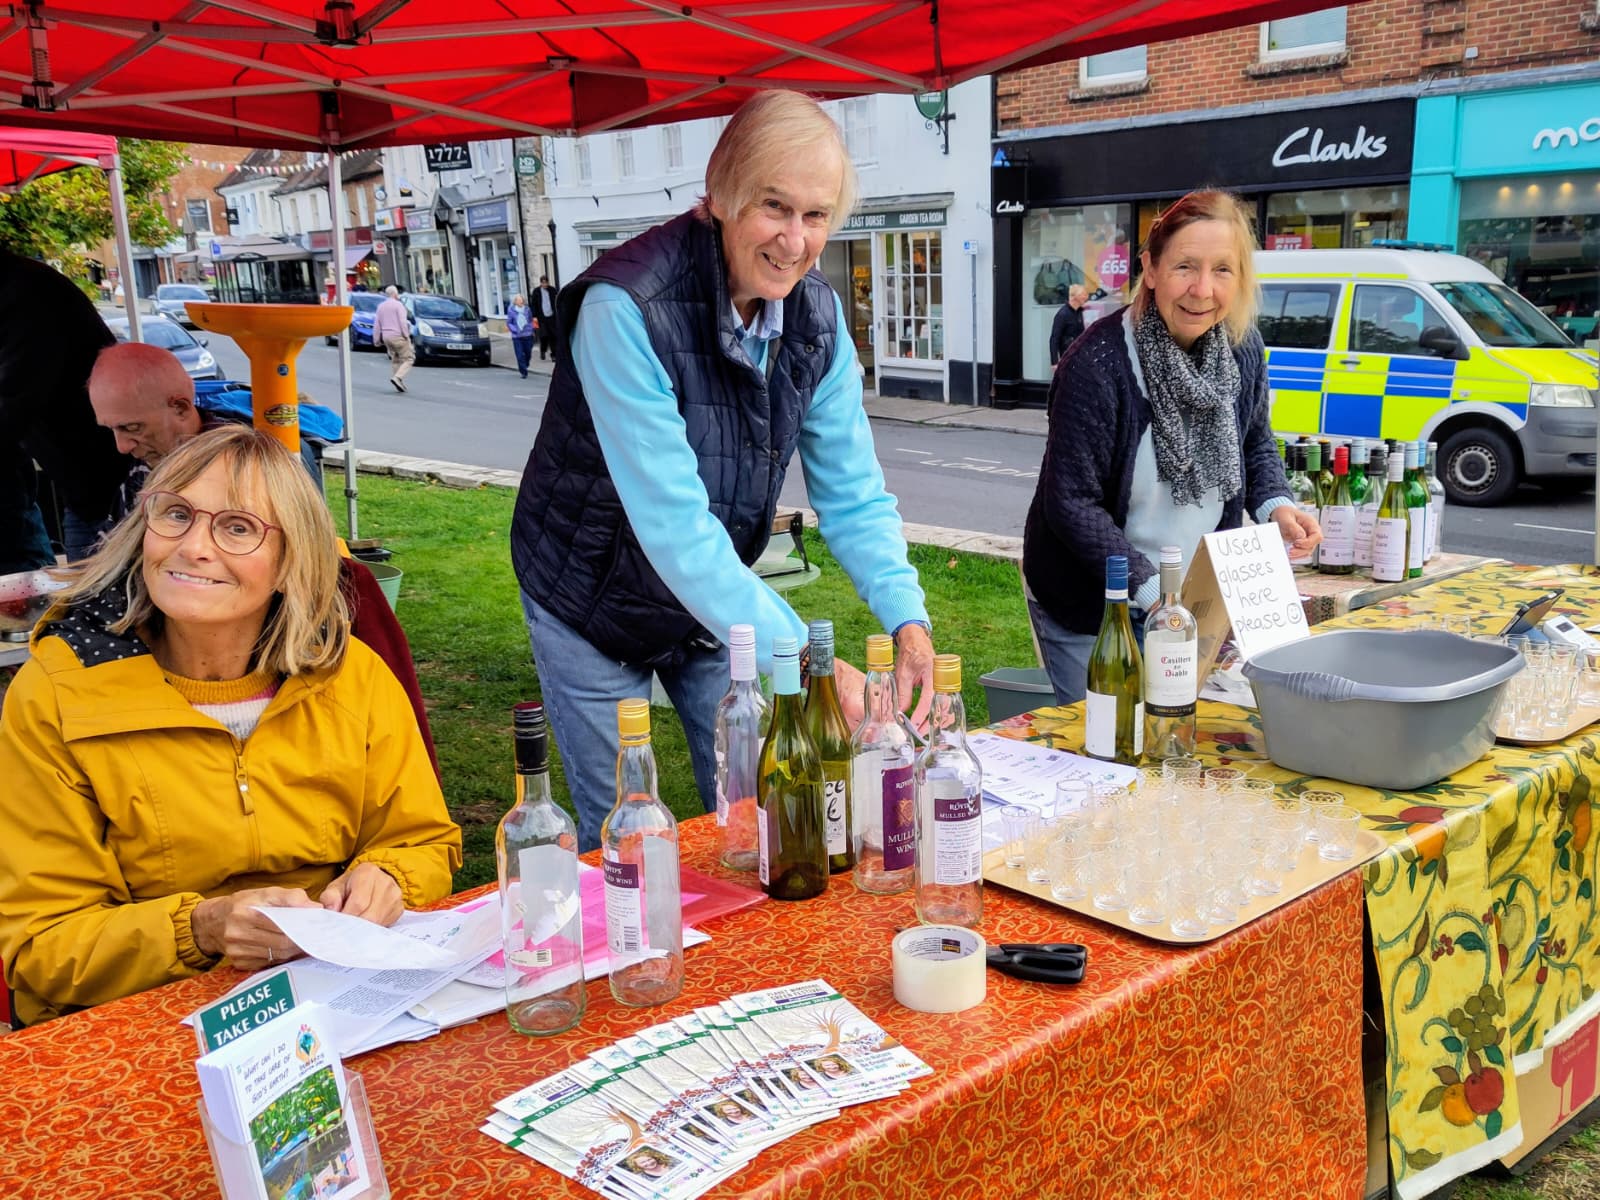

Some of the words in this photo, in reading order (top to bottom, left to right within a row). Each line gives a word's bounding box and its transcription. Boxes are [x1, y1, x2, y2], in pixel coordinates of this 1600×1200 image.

[428, 146, 462, 162] 1777
[1272, 125, 1388, 168] Clarks
[996, 200, 1025, 213] Clarks
[851, 216, 864, 227] EAST
[865, 215, 886, 226] DORSET
[899, 213, 919, 224] GARDEN
[920, 212, 929, 223] TEA
[929, 211, 944, 222] ROOM
[1101, 259, 1128, 274] £65
[1217, 529, 1263, 556] Used
[1219, 561, 1274, 598] glasses
[1236, 586, 1279, 608] here
[1235, 612, 1286, 647] please
[939, 811, 967, 819] MULLED
[888, 828, 915, 844] MULL
[616, 877, 633, 885] WINE
[220, 984, 273, 1021] PLEASE
[213, 1014, 251, 1046] TAKE
[254, 998, 289, 1025] ONE
